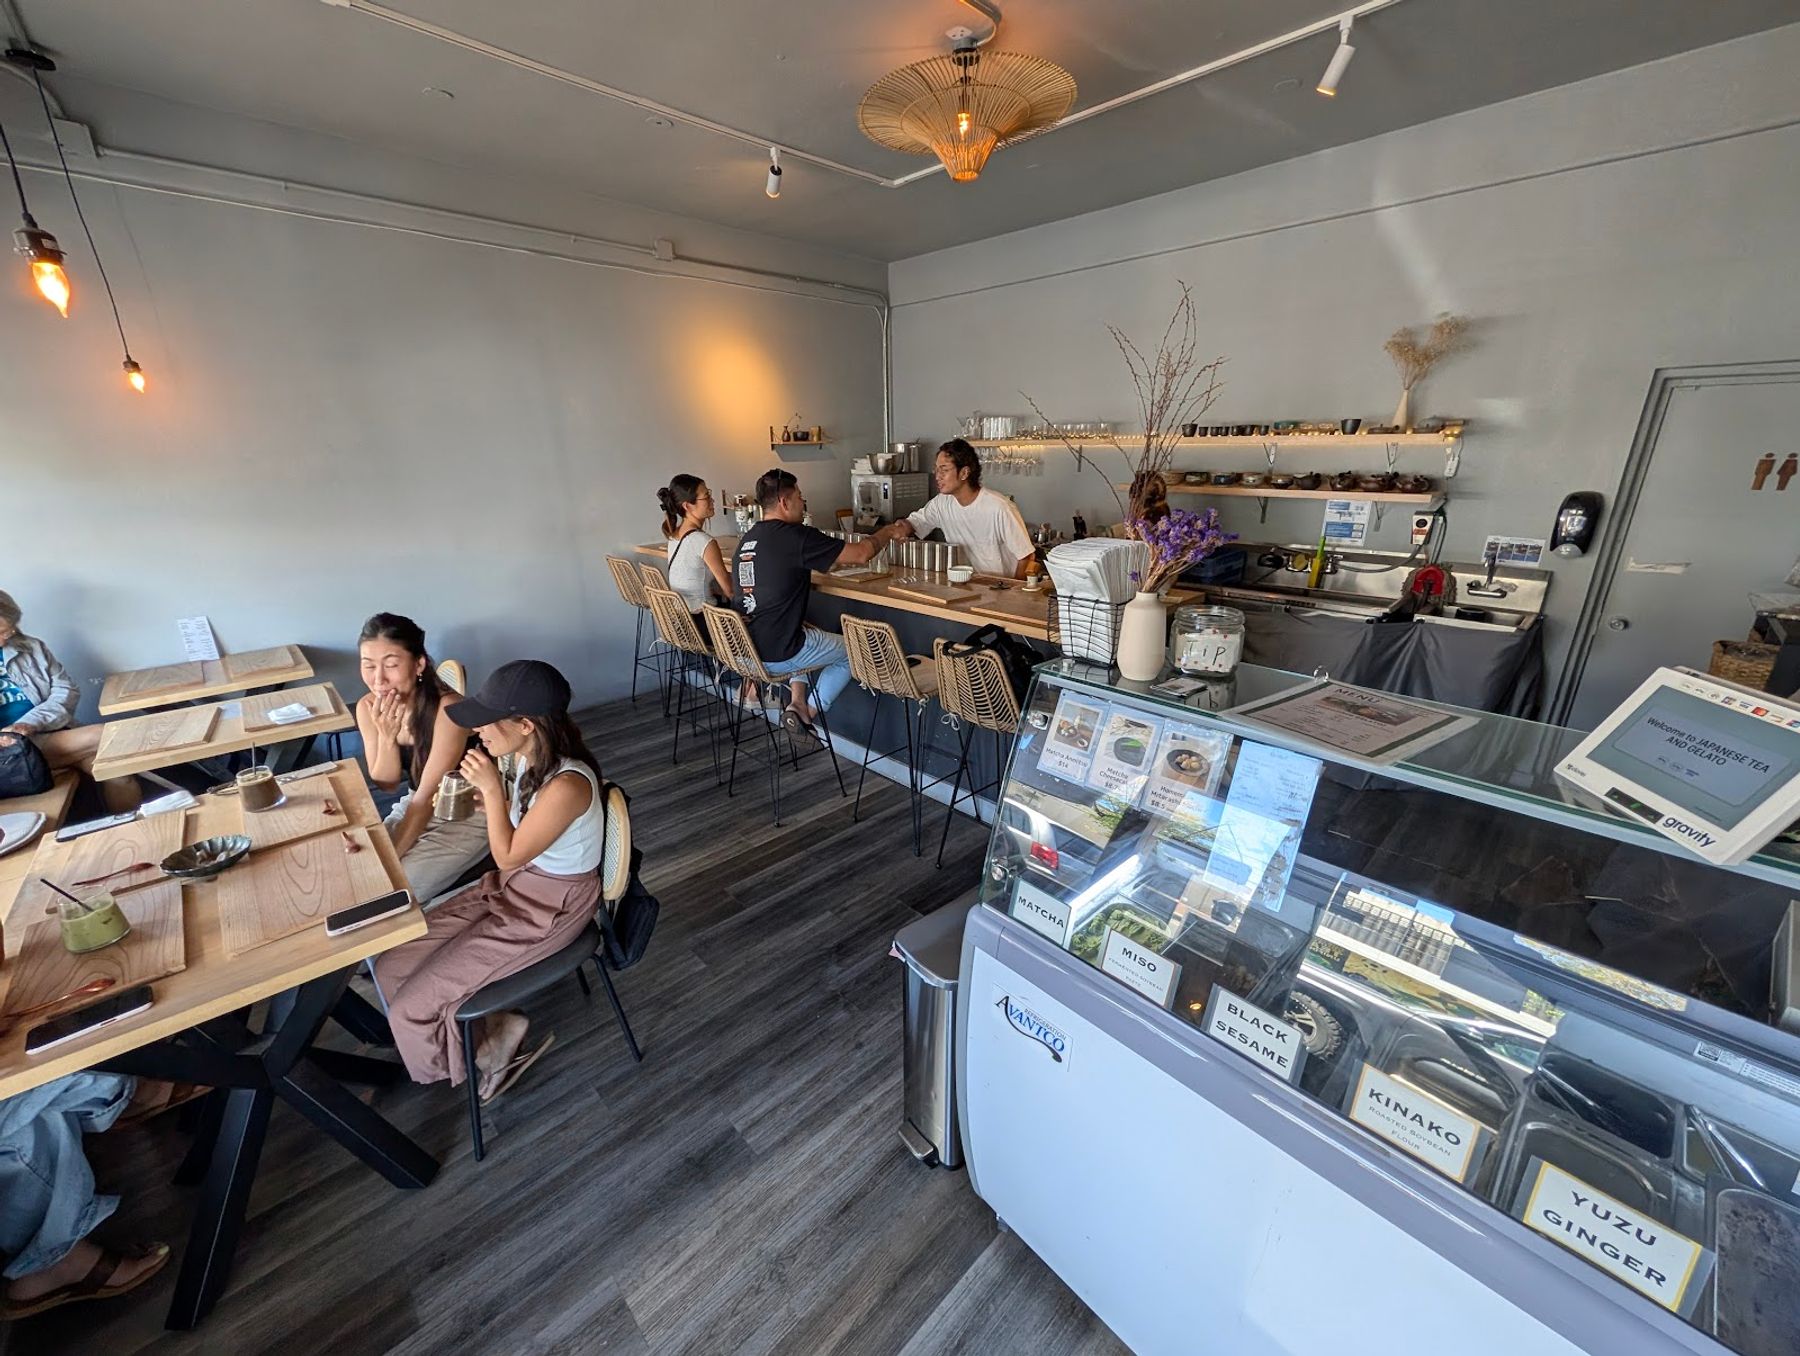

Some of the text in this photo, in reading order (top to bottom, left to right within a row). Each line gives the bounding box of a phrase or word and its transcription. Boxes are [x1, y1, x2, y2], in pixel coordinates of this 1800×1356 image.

[1334, 688, 1380, 704] MENU
[1647, 716, 1771, 774] Welcome to JAPANESE TEA
[1666, 736, 1727, 766] AND GELATO
[1662, 816, 1717, 848] gravity
[1018, 895, 1065, 928] MATCHA
[1121, 947, 1157, 973] MISO
[995, 995, 1065, 1062] AVANTCO
[1215, 1020, 1288, 1069] SESAME
[1227, 1002, 1288, 1044] BLACK
[1368, 1087, 1461, 1146] KINAKO
[1368, 1105, 1452, 1158] ROASTED SOYBEAN
[1391, 1128, 1420, 1151] FLOUR
[1571, 1190, 1657, 1246] YUZU
[1543, 1209, 1667, 1288] GINGER
